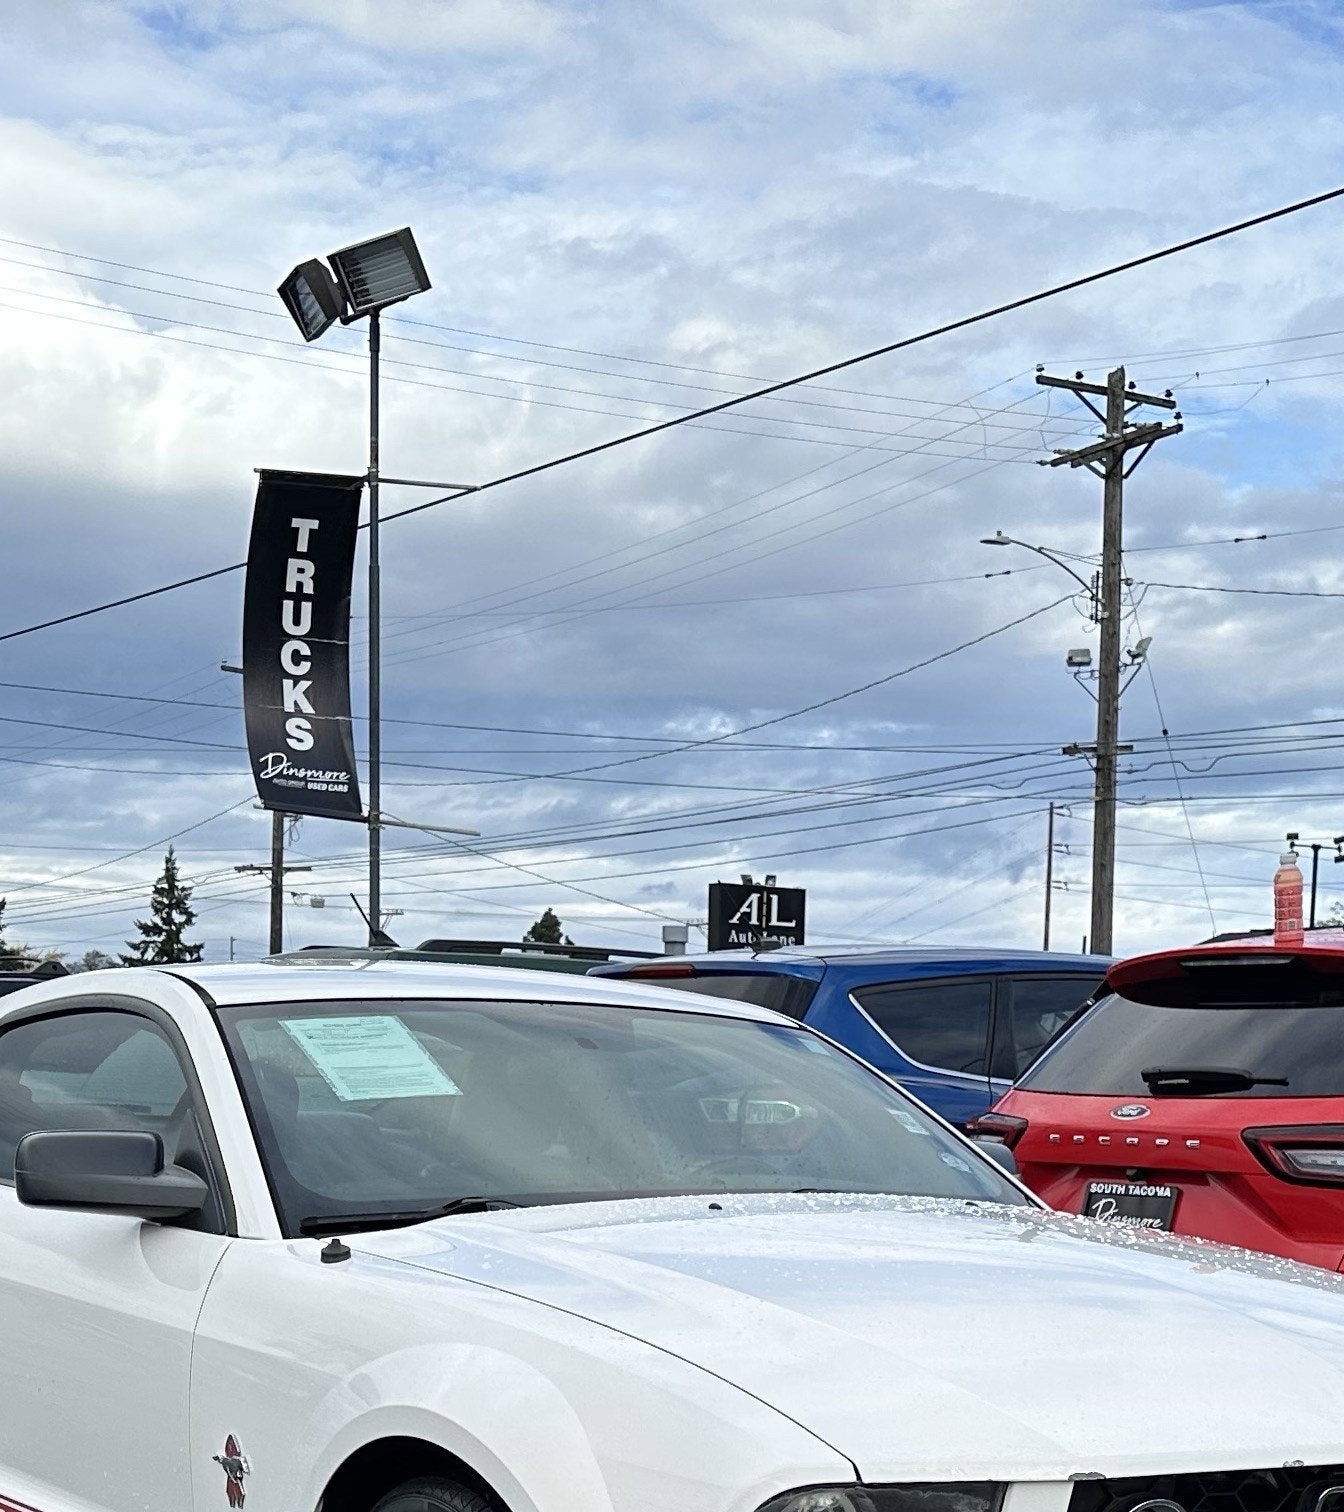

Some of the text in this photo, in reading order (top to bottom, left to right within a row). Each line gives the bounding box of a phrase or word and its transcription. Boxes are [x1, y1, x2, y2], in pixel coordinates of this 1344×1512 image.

[280, 518, 320, 751] TRUCKS
[259, 752, 351, 780] Dinsmore
[1089, 1183, 1126, 1195] SOUTH
